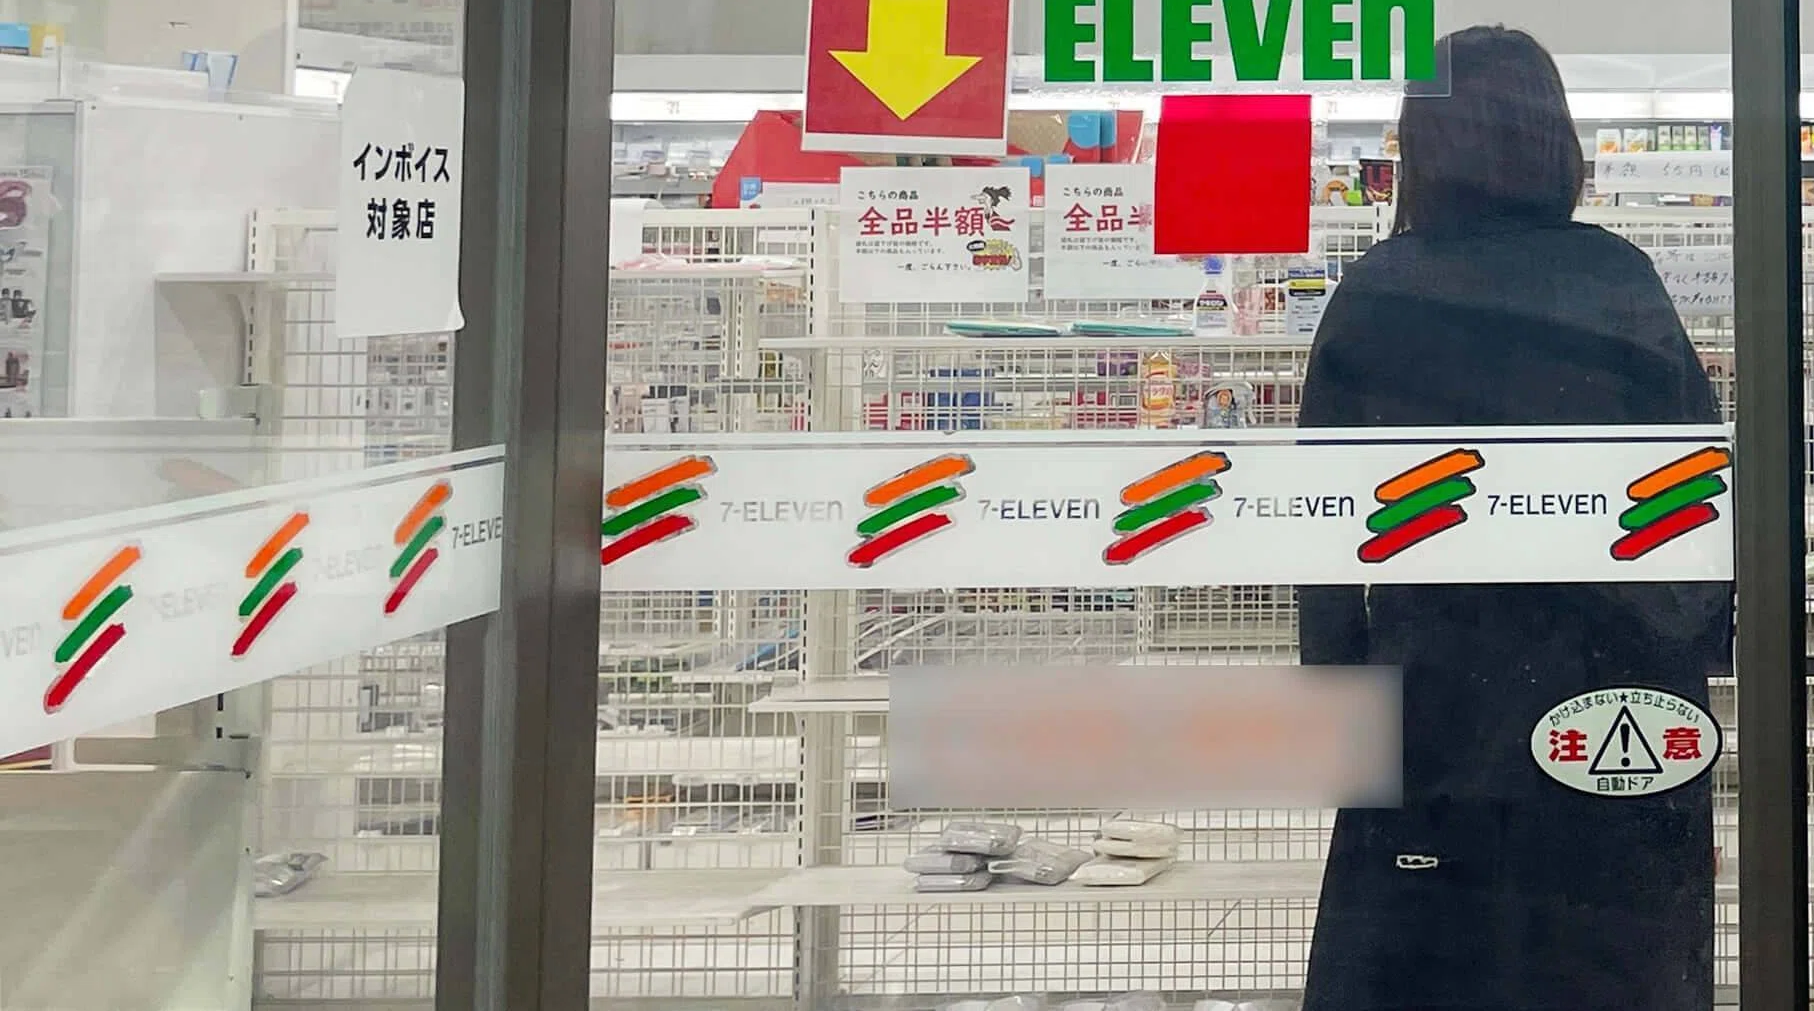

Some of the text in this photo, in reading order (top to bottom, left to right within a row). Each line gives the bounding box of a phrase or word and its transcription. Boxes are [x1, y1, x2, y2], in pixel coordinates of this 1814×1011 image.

[352, 142, 450, 183] インボイス
[857, 190, 919, 201] こちらの商品
[1063, 187, 1124, 198] こちらの商品
[365, 197, 437, 240] 対象店
[1596, 776, 1655, 792] 自動ドア
